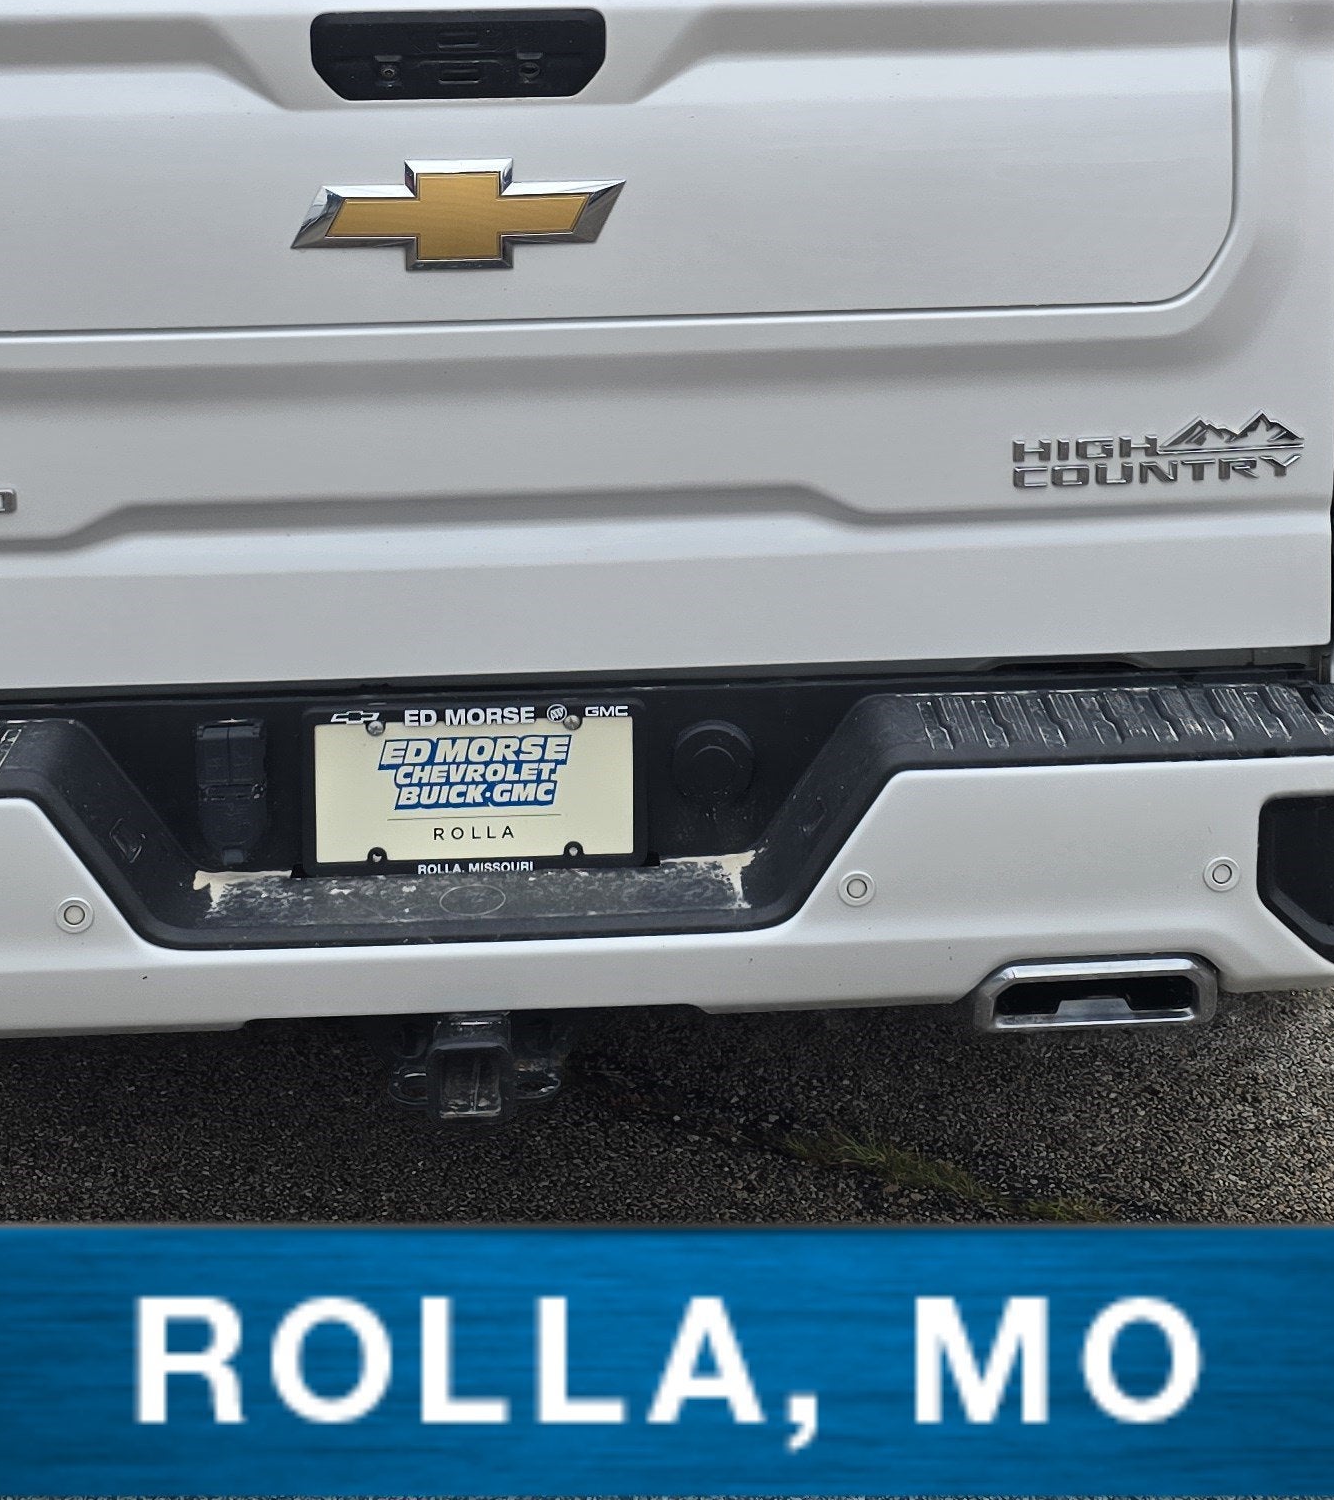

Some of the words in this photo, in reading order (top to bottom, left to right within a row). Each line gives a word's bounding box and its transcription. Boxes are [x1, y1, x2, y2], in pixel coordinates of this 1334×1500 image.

[1012, 434, 1159, 463] HIGH
[1013, 454, 1302, 488] COUNTRY
[404, 709, 438, 727] ED
[444, 706, 536, 726] MORSE
[584, 705, 629, 717] GMC
[381, 739, 431, 765] ED
[435, 734, 571, 763] MORSE
[396, 761, 557, 785] CHEVROLET
[433, 825, 515, 841] ROLLA
[468, 860, 535, 874] MISSOURI
